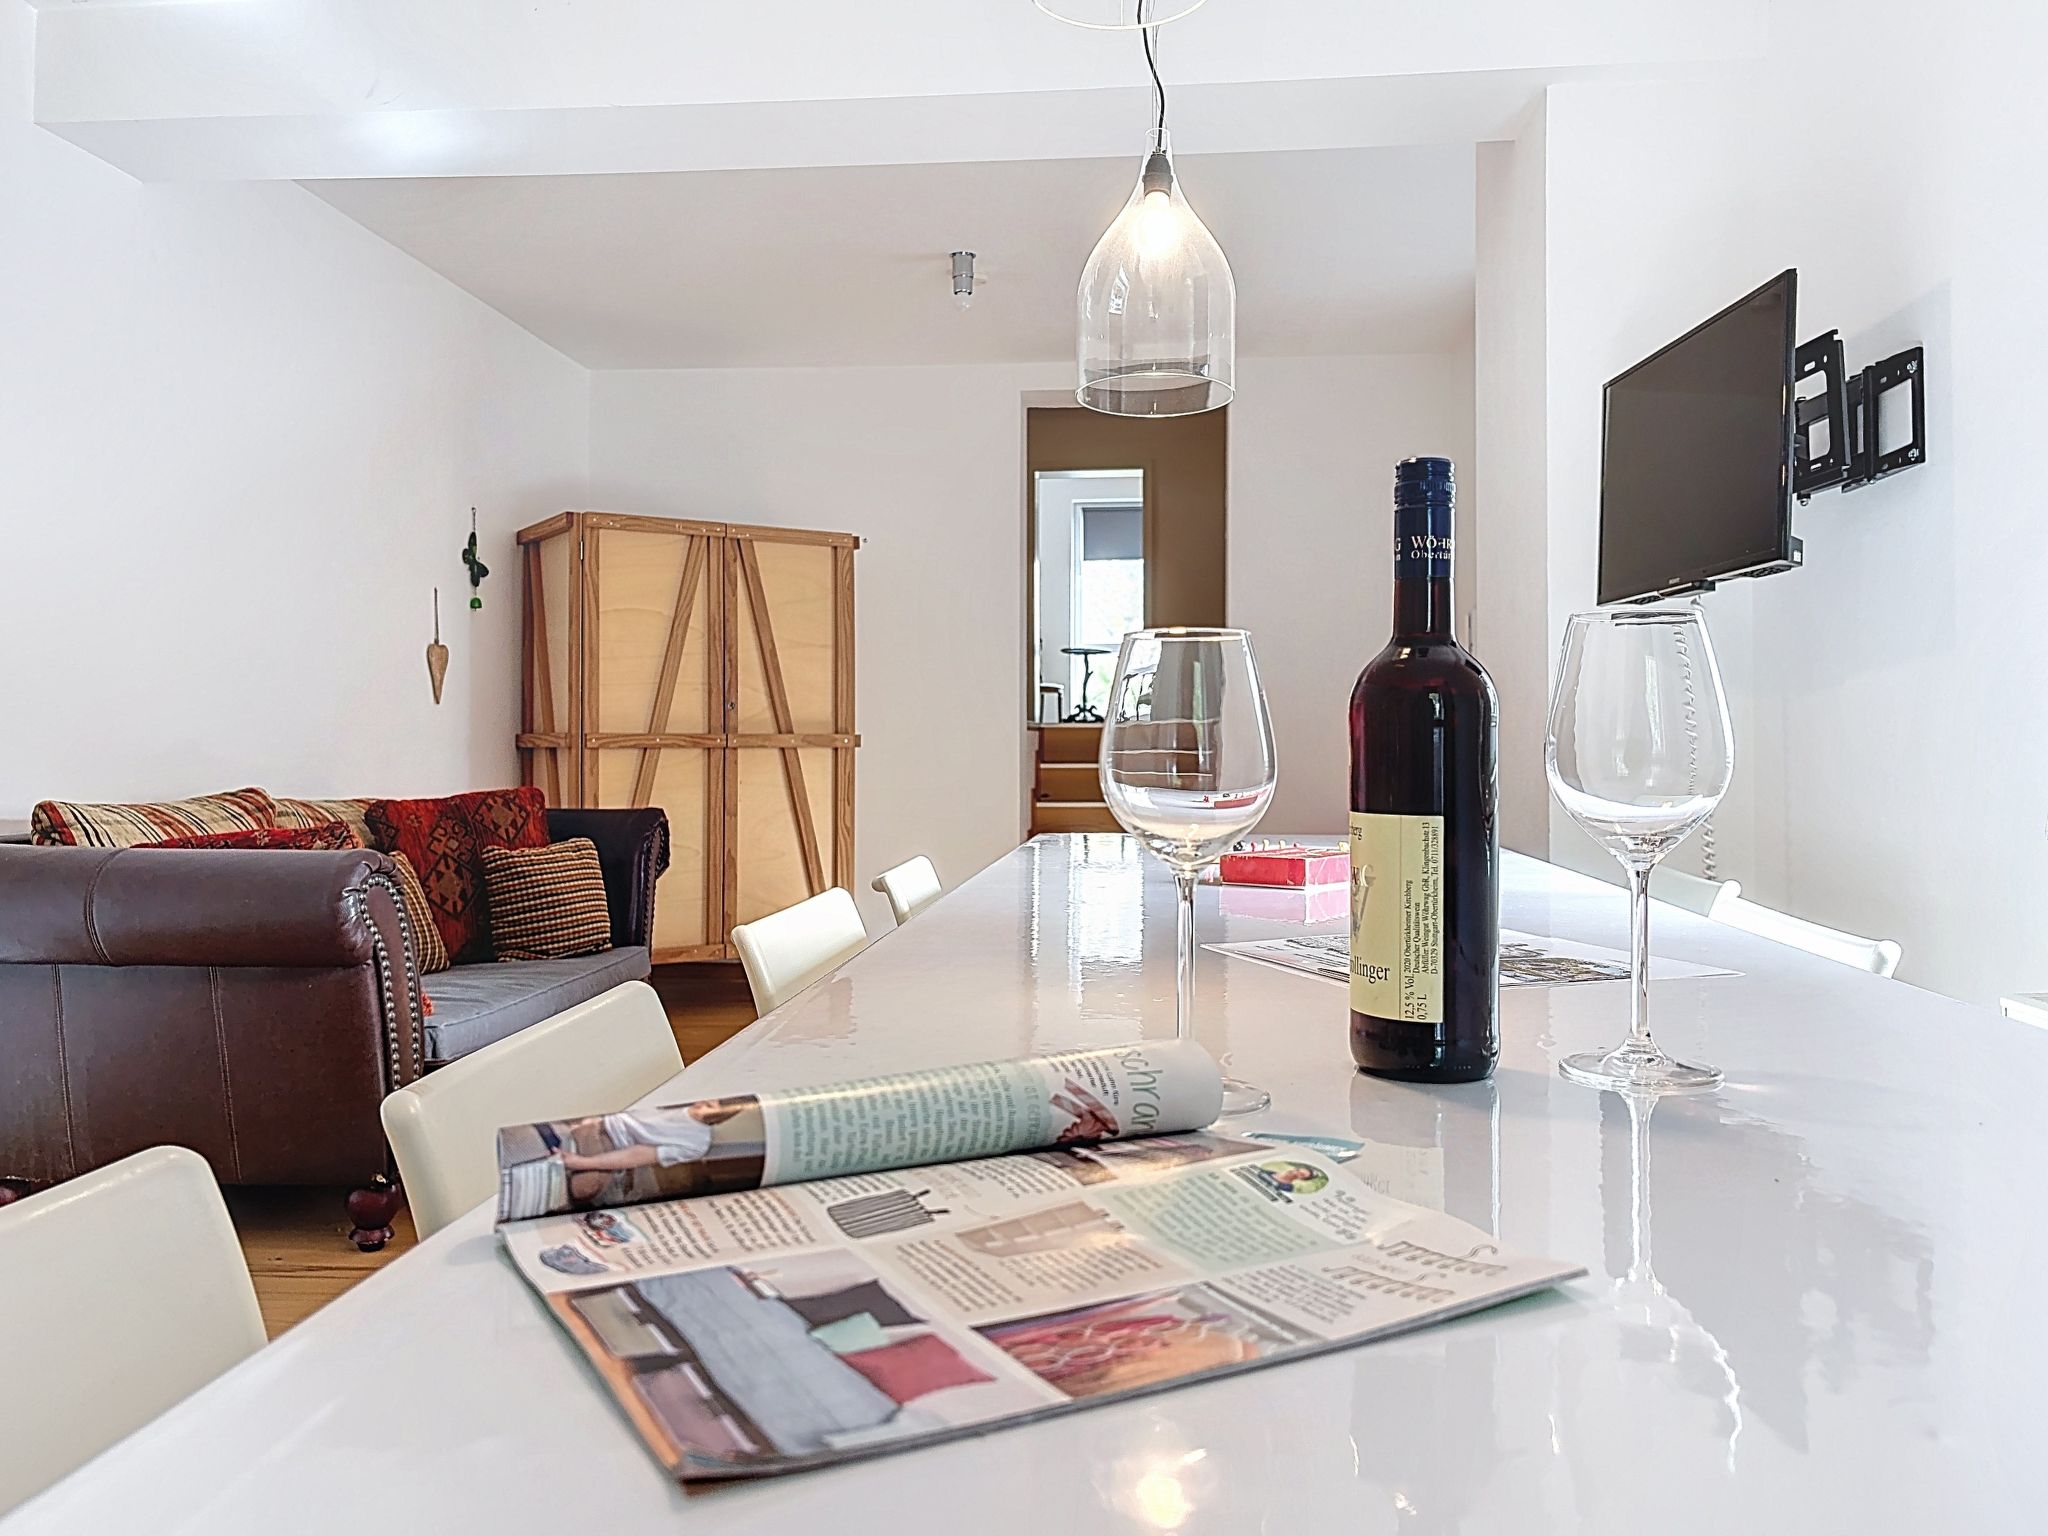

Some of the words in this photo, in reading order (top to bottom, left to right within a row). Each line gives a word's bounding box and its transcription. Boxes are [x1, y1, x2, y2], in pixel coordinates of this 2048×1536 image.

[1404, 879, 1414, 910] Kirchberg
[1404, 958, 1412, 974] 2020
[1412, 944, 1421, 974] Deutscher
[1405, 991, 1415, 1001] %
[1404, 1003, 1415, 1019] 12,5
[1416, 1003, 1427, 1020] 0,75
